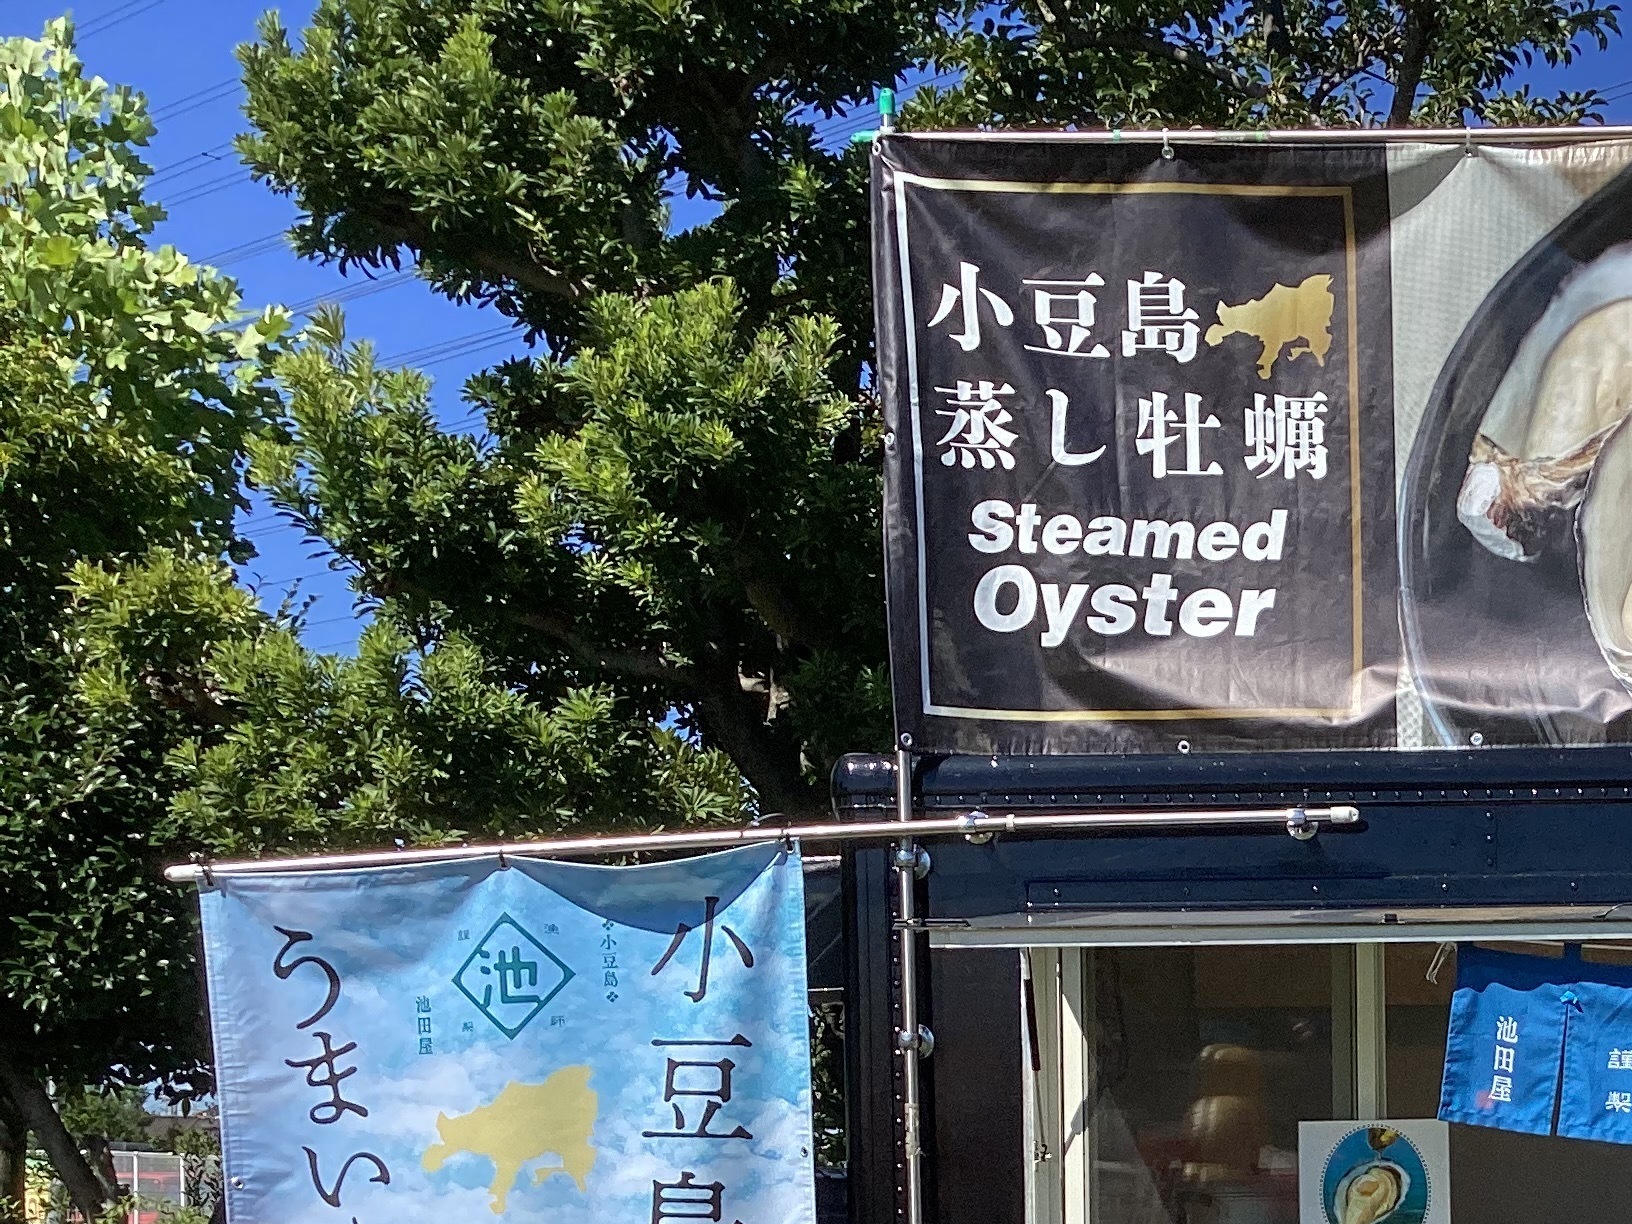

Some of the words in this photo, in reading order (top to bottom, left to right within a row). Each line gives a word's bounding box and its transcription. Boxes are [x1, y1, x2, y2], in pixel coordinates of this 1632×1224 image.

[927, 260, 1202, 364] 小豆島
[934, 379, 1330, 481] 蒸し牡蠣
[967, 500, 1290, 563] Steamed
[972, 564, 1278, 648] Oyster
[480, 945, 538, 1008] 池
[600, 934, 619, 988] 小豆島
[415, 995, 433, 1056] 池田屋
[1488, 1015, 1519, 1104] 池田屋
